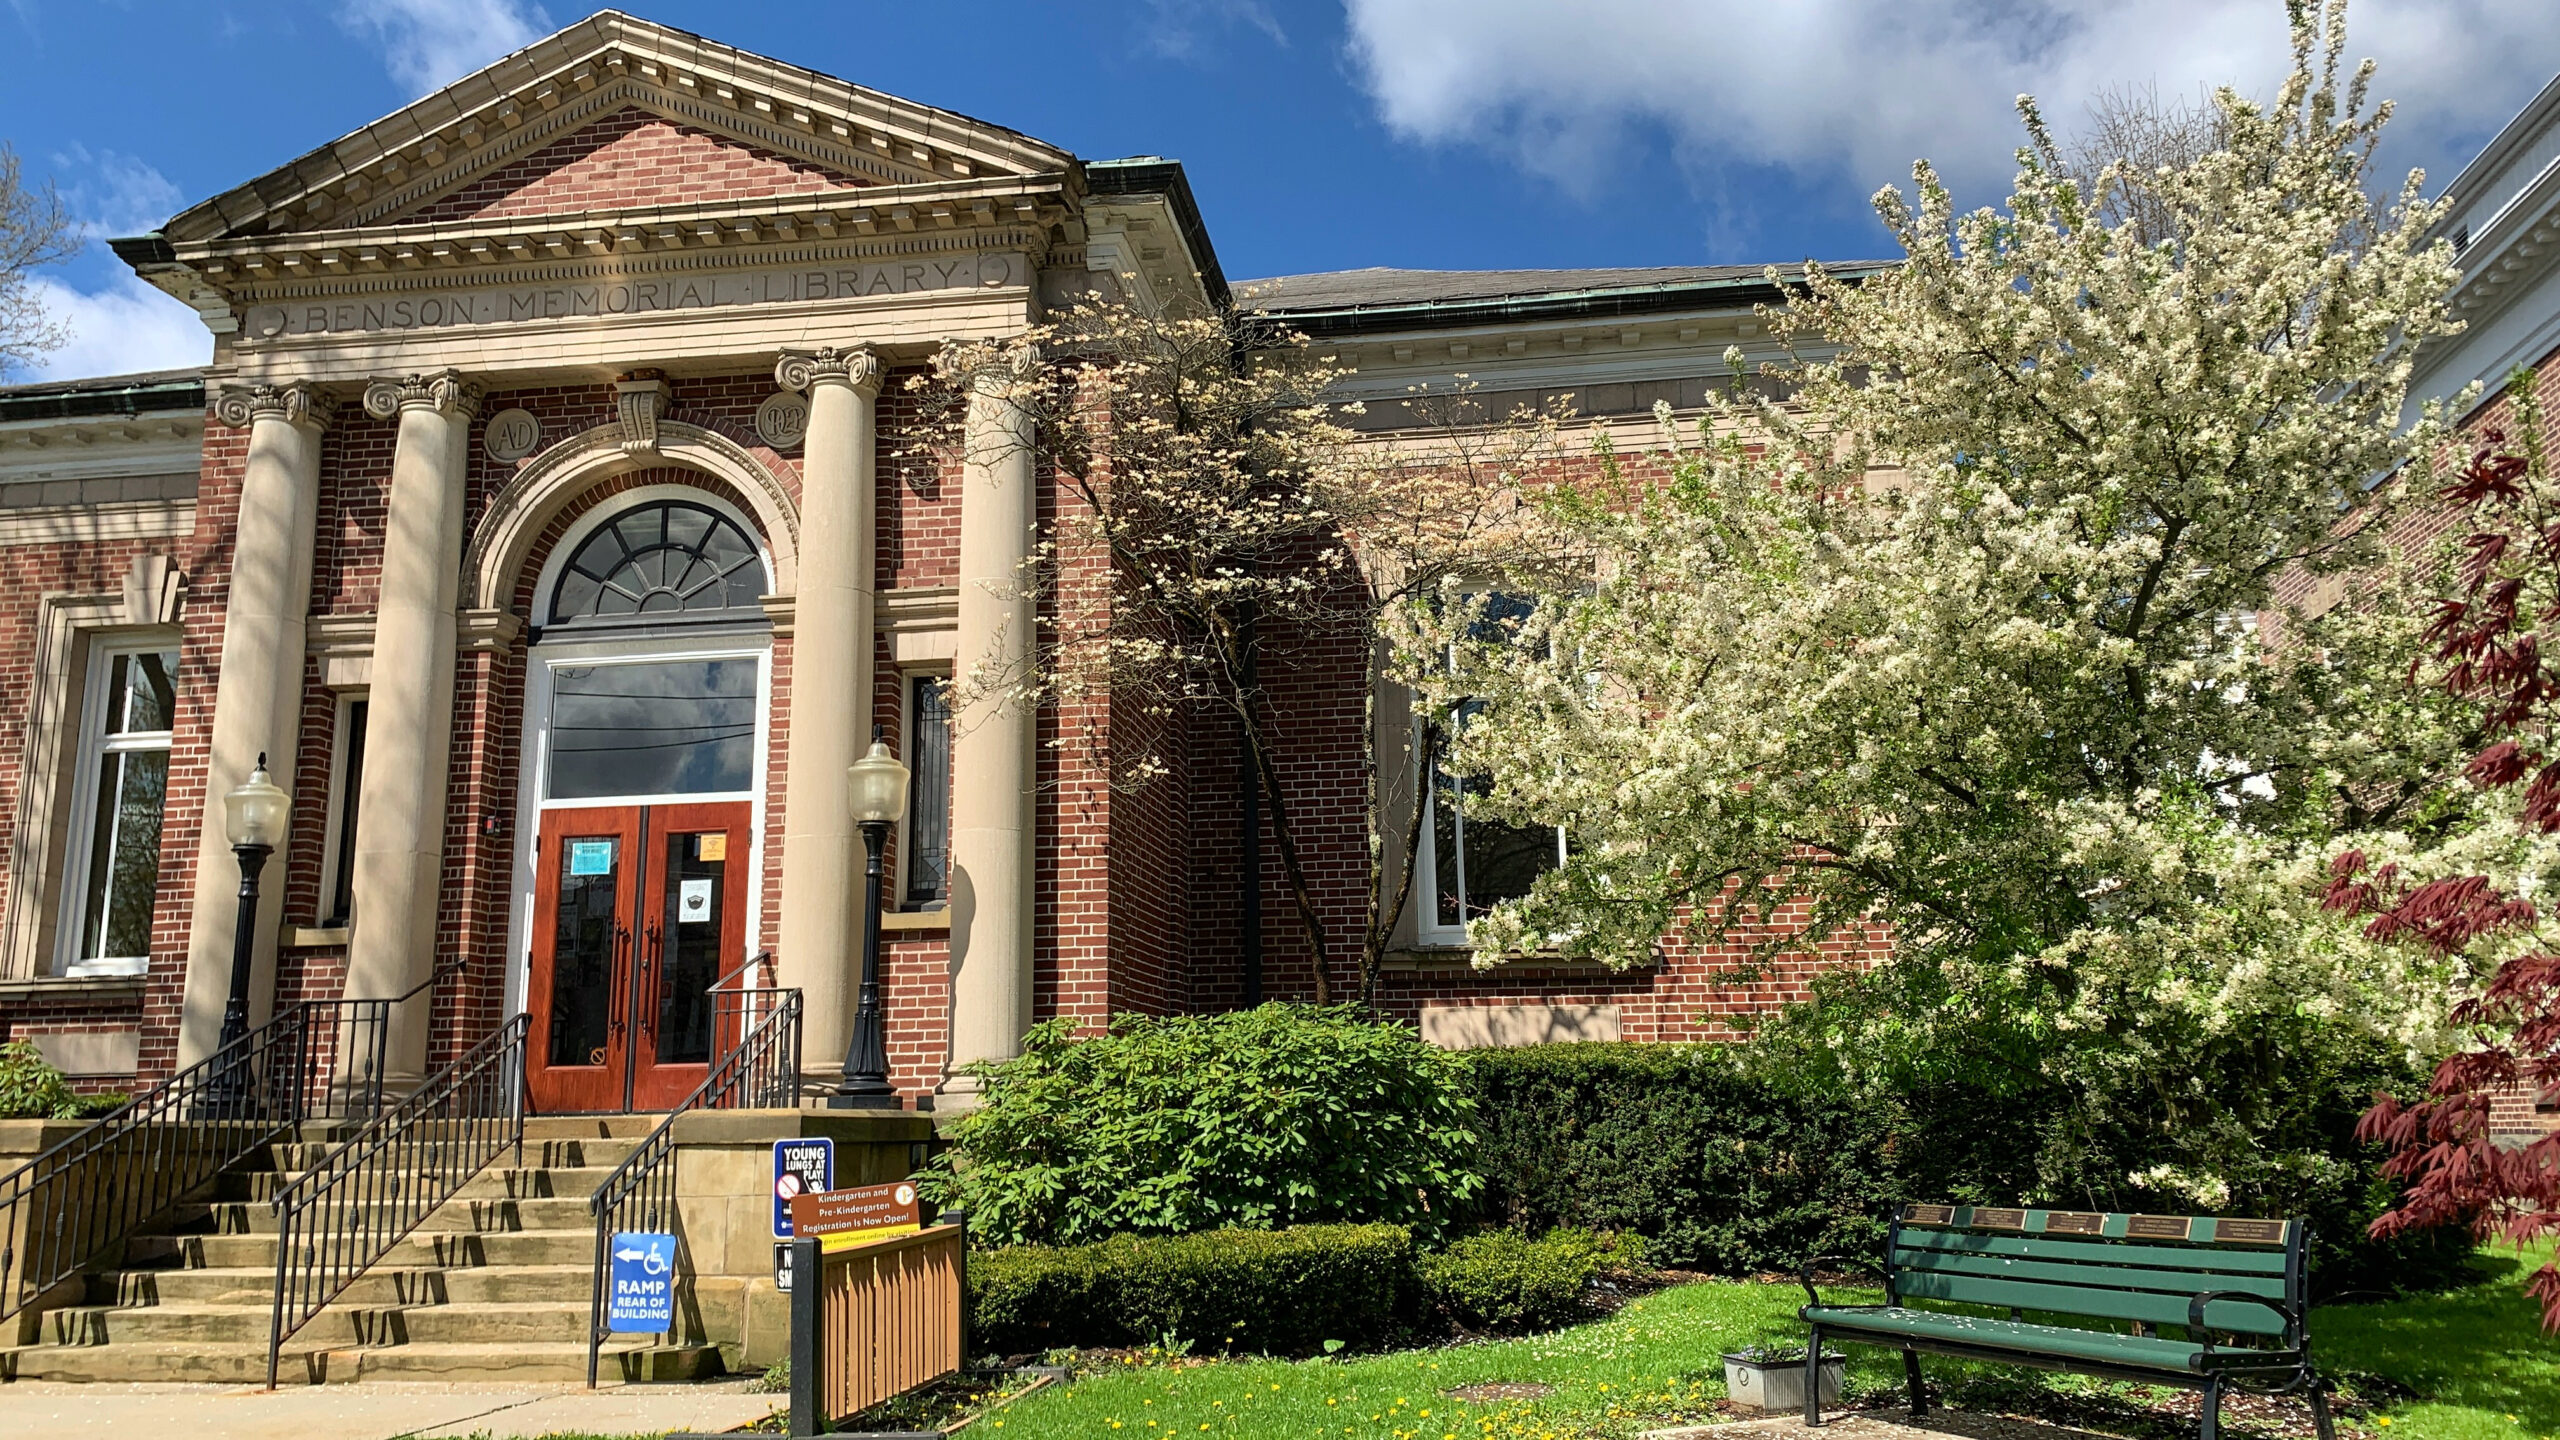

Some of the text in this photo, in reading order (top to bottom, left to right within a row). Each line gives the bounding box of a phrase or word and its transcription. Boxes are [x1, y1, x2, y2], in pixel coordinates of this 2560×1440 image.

[305, 260, 960, 334] BENSON MEMORIAL LIBRARY
[784, 1147, 826, 1161] YOUNG
[786, 1160, 825, 1171] LUNGS AT
[803, 1170, 824, 1180] PLAY!
[818, 1187, 889, 1204] Kindergarten and
[819, 1202, 890, 1218] Pre-Kindergarten
[802, 1213, 909, 1234] Registration Is Now Open!
[833, 1235, 866, 1245] enrollment
[867, 1232, 885, 1241] online
[784, 1248, 793, 1269] N
[617, 1280, 665, 1295] RAMP
[617, 1297, 665, 1308] REAR OF
[612, 1308, 669, 1320] BUILDING
